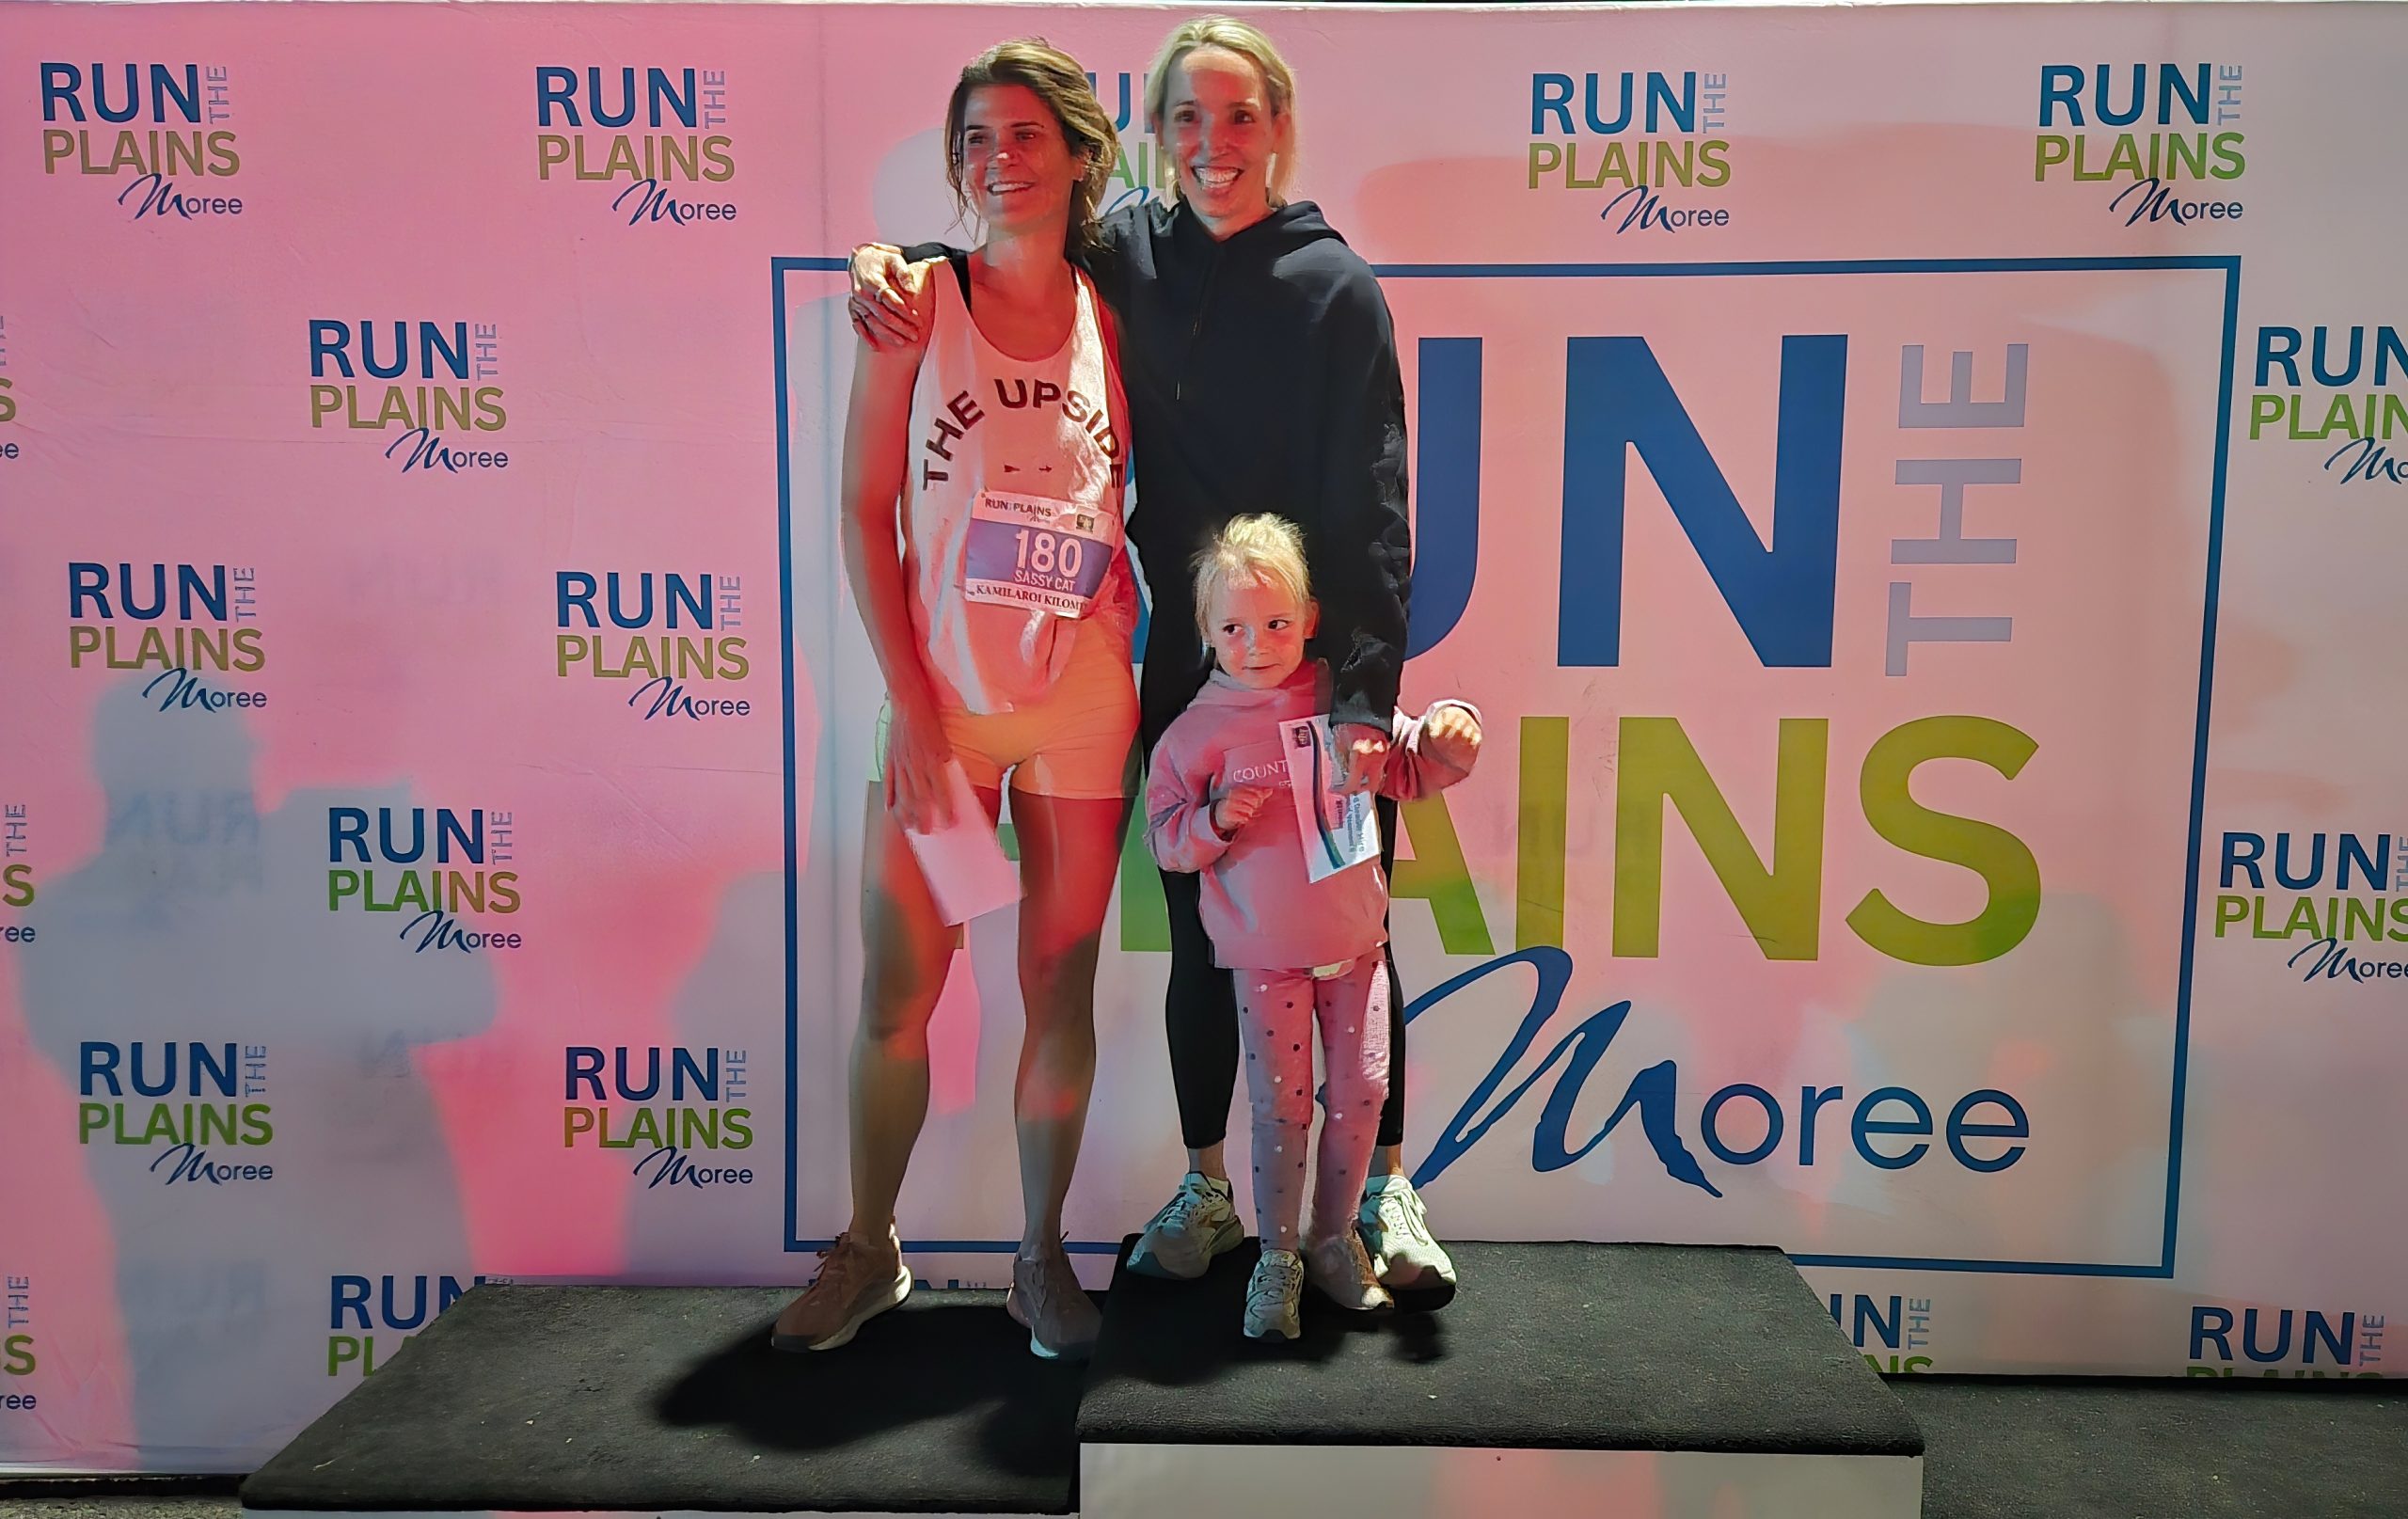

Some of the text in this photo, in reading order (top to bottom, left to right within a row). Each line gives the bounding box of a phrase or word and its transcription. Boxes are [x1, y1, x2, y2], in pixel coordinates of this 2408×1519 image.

[40, 61, 231, 124] RUN THE
[536, 66, 726, 130] RUN THE
[1530, 71, 1727, 134] RUN THE
[2039, 63, 2242, 128] RUN THE
[43, 129, 241, 177] PLAINS
[537, 134, 736, 182] PLAINS
[1529, 140, 1731, 189] PLAINS
[2035, 133, 2246, 182] PLAINS
[118, 173, 243, 220] Moree
[611, 180, 737, 226] Moree
[1602, 184, 1730, 234] Moree
[2109, 177, 2244, 227] Moree
[309, 320, 499, 381] RUN THE
[2255, 325, 2408, 387] RUN
[310, 385, 507, 431] PLAINS
[384, 428, 509, 473] Moree
[923, 390, 986, 491] THE
[985, 498, 1008, 511] RUN
[1014, 502, 1052, 516] PLAINS
[1885, 342, 2029, 677] THE
[1016, 528, 1083, 578] 180
[68, 562, 257, 623] RUN THE
[555, 571, 713, 630] RUN
[720, 576, 742, 631] THE
[976, 584, 1041, 603] KAMILAROI
[1015, 570, 1076, 593] SASSY CAT
[70, 626, 266, 672] PLAINS
[557, 635, 750, 681] PLAINS
[142, 667, 267, 713] Moree
[627, 676, 751, 721] Moree
[5, 804, 27, 858] THE
[328, 807, 484, 864] RUN
[491, 811, 514, 865] THE
[2220, 832, 2390, 891] RUN
[328, 870, 521, 914] PLAINS
[399, 910, 522, 954] Moree
[2288, 937, 2408, 984] More
[79, 1041, 238, 1098] RUN
[564, 1046, 748, 1102] RUN THE
[1315, 947, 2030, 1197] Moree
[79, 1103, 274, 1147] PLAINS
[564, 1107, 753, 1150] PLAINS
[150, 1143, 274, 1186] Moree
[632, 1147, 753, 1190] Moree
[1908, 1298, 1931, 1351] THE
[2189, 1306, 2384, 1367] RUN THE
